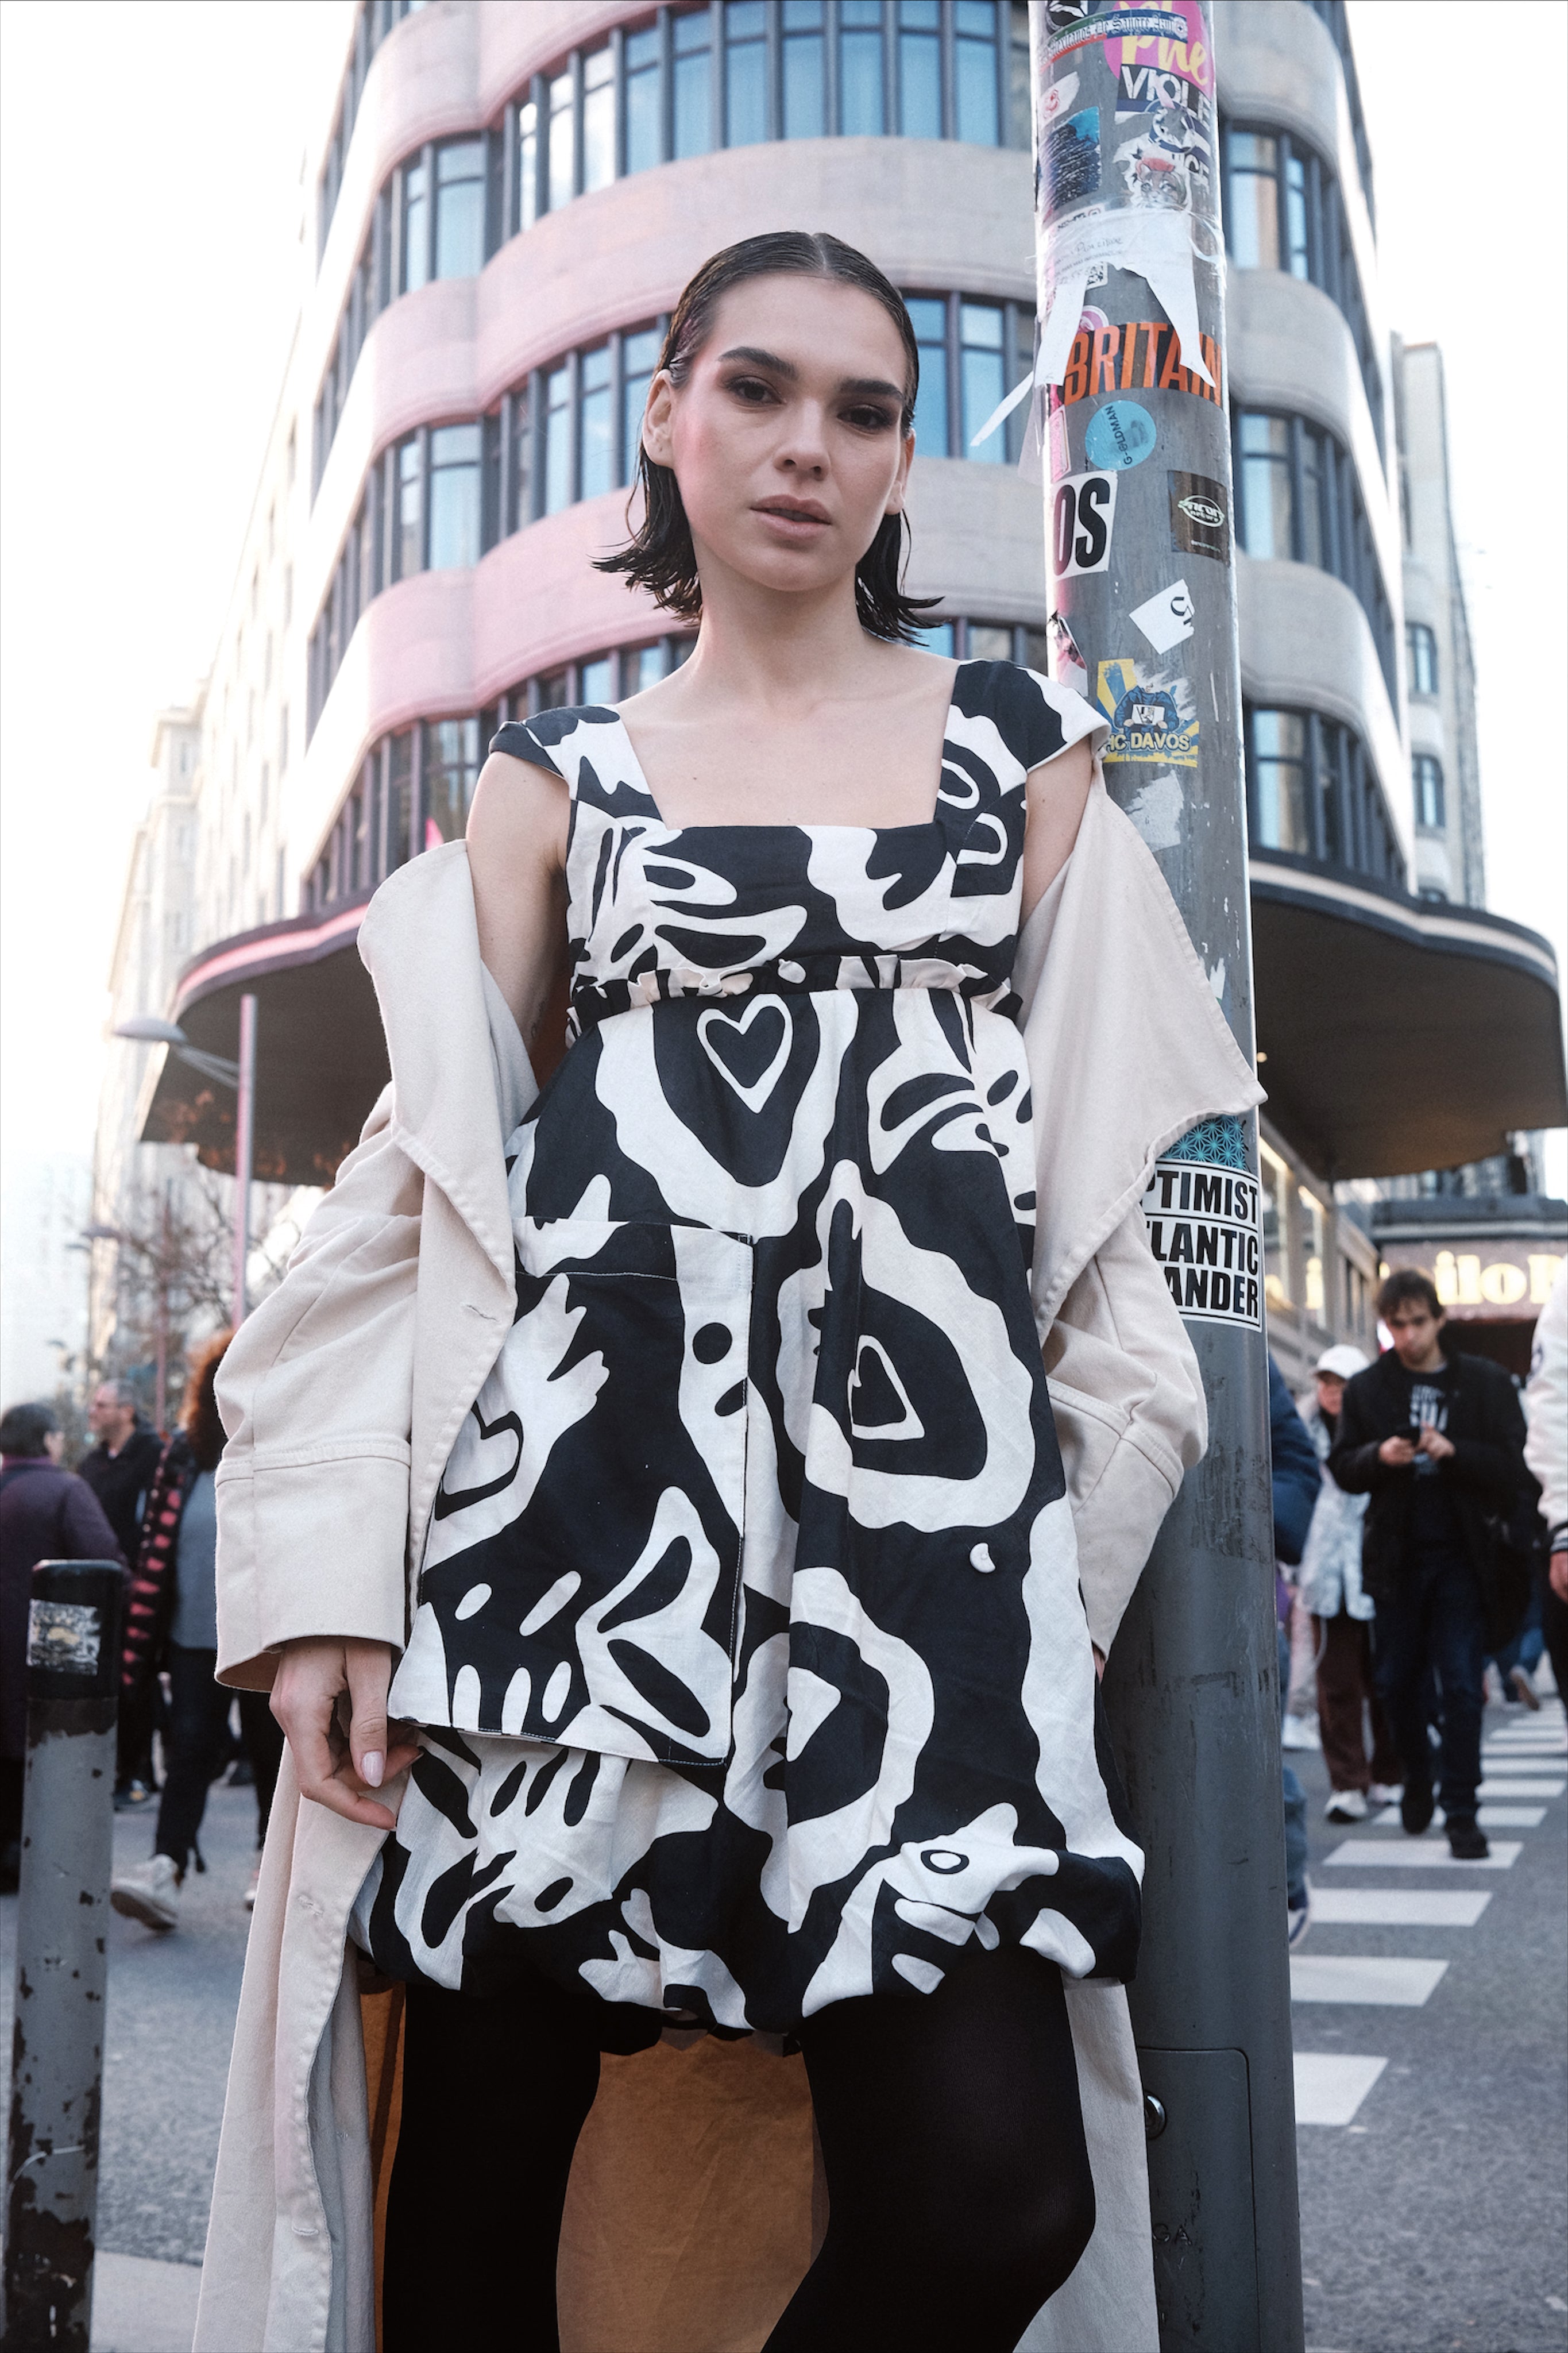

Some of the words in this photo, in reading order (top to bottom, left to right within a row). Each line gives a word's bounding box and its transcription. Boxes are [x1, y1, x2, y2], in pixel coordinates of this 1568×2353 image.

[1053, 477, 1111, 576] OS
[1130, 732, 1190, 751] DAVOS
[1140, 1170, 1258, 1224] TIMIST
[1146, 1221, 1258, 1276] LANTIC
